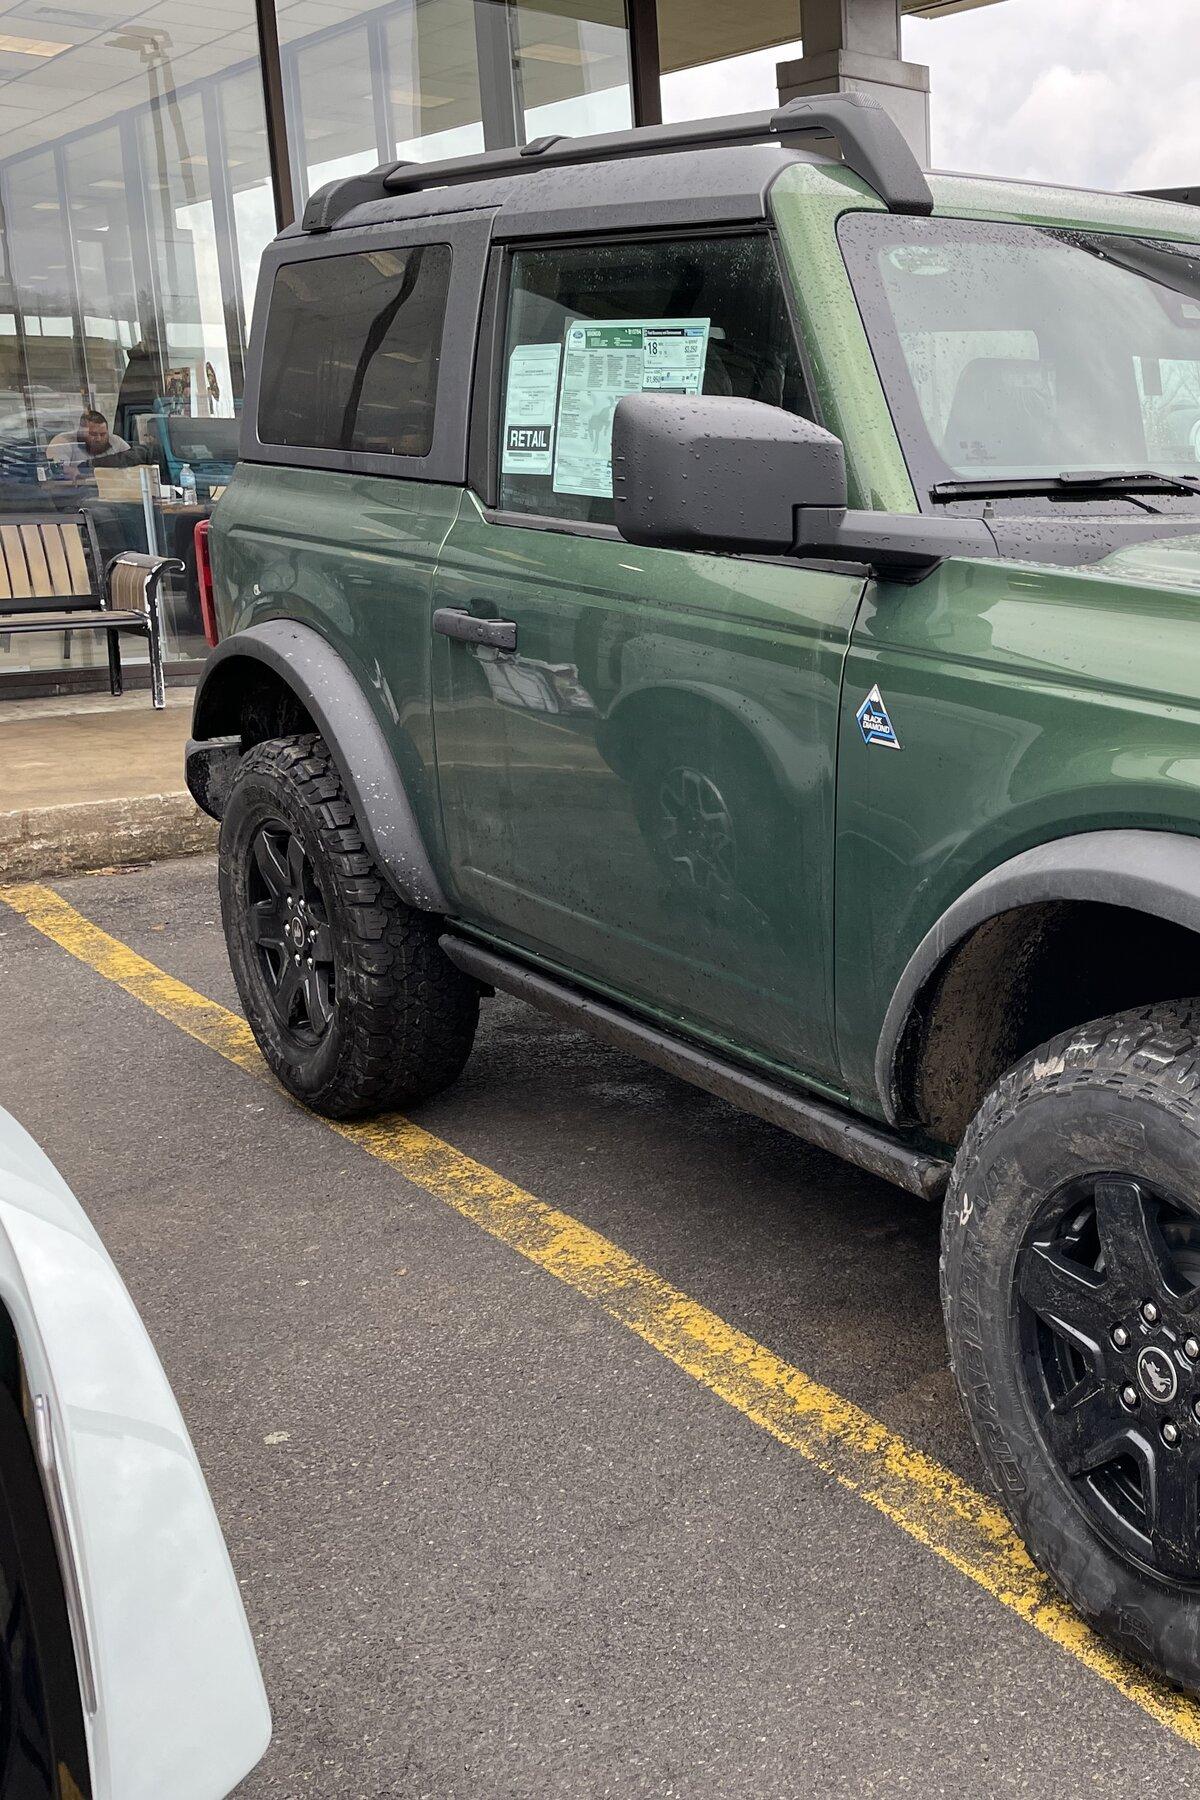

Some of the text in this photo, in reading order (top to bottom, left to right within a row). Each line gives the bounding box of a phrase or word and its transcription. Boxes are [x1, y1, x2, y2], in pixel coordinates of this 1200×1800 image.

[647, 341, 658, 355] 18
[510, 429, 547, 448] RETAIL
[863, 713, 883, 724] BLACK
[862, 720, 890, 733] DIAMOND
